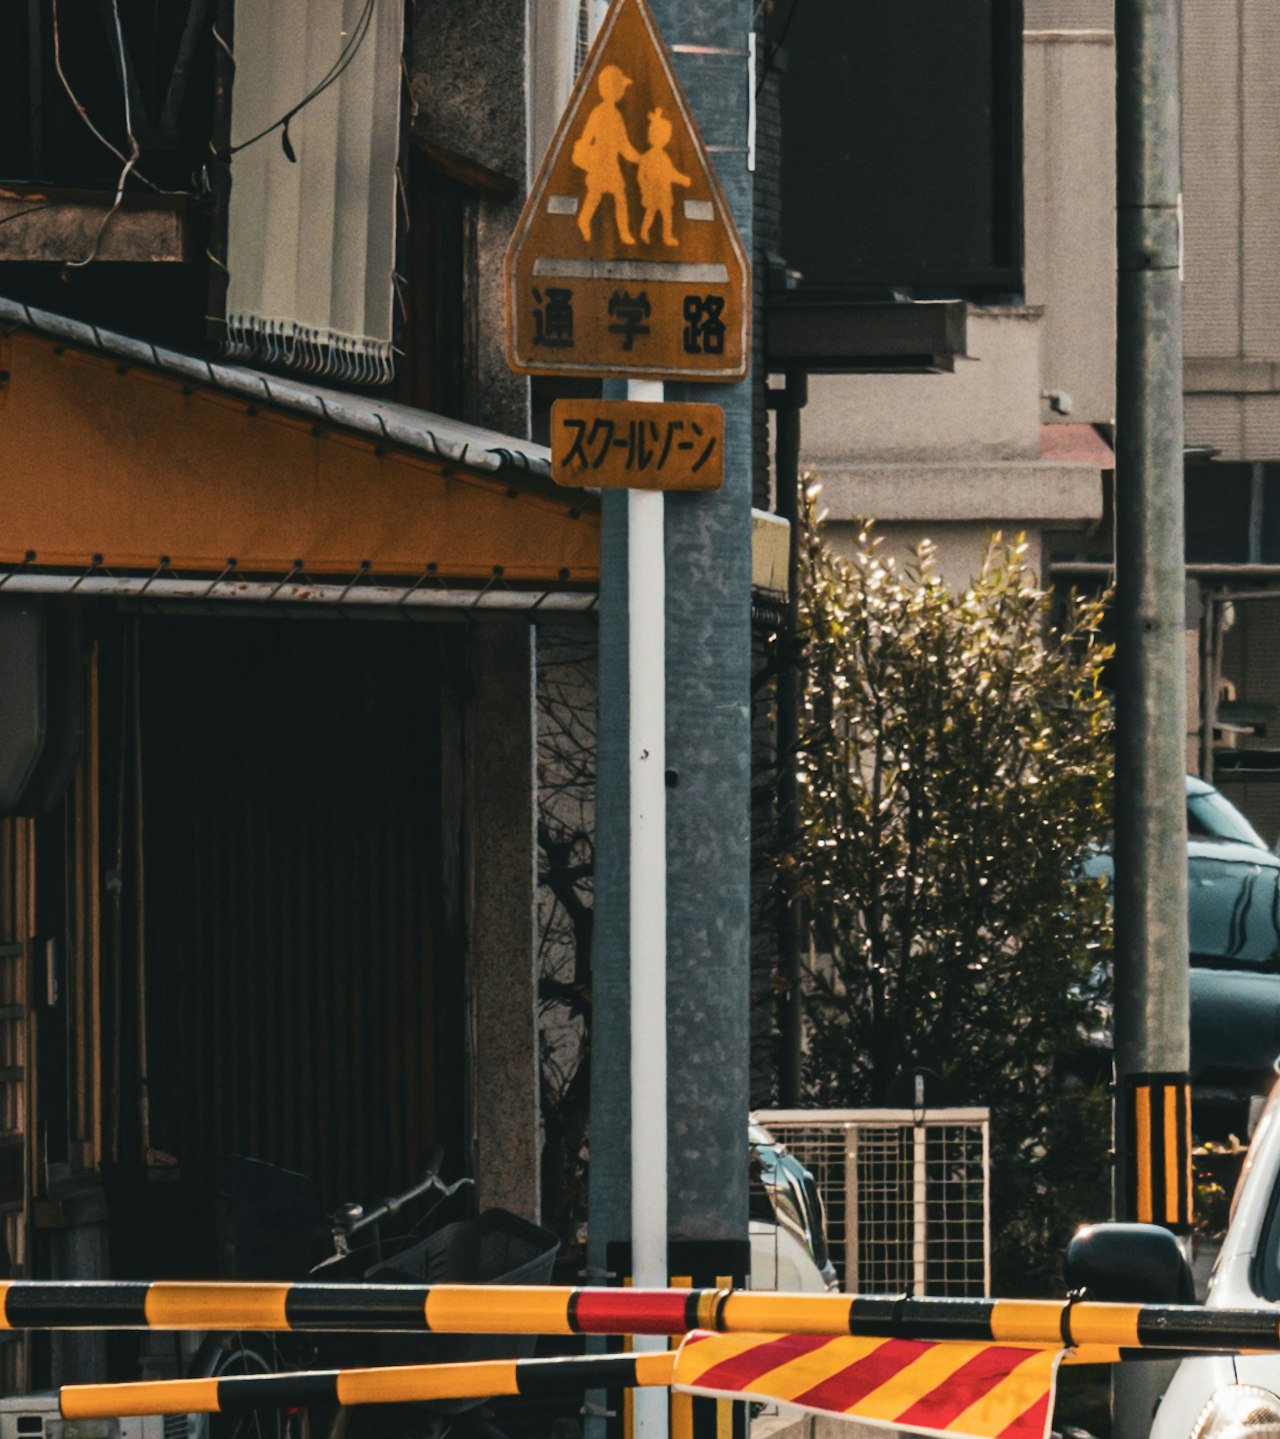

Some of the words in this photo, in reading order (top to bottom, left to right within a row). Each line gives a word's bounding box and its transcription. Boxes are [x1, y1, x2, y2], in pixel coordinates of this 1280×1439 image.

[532, 287, 727, 356] 通学路
[561, 418, 717, 472] スクールゾーン
